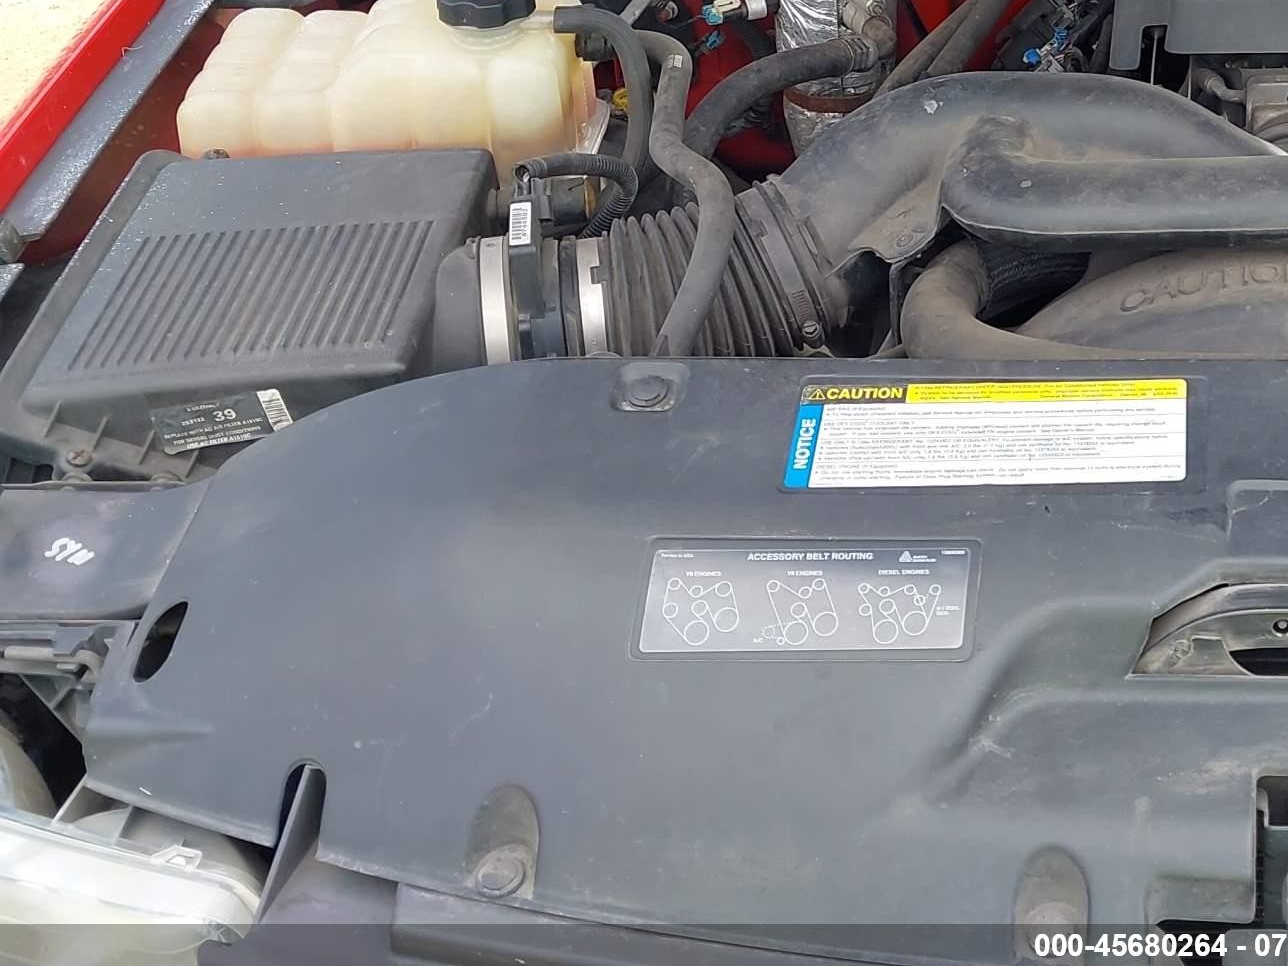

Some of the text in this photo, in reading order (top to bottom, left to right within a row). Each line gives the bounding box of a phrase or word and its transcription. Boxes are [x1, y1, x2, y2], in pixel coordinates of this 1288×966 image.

[826, 387, 903, 399] CAUTION
[212, 408, 237, 422] 39
[792, 418, 817, 470] NOTICE
[747, 553, 805, 561] ACCESSORY
[831, 552, 874, 560] ROUTING
